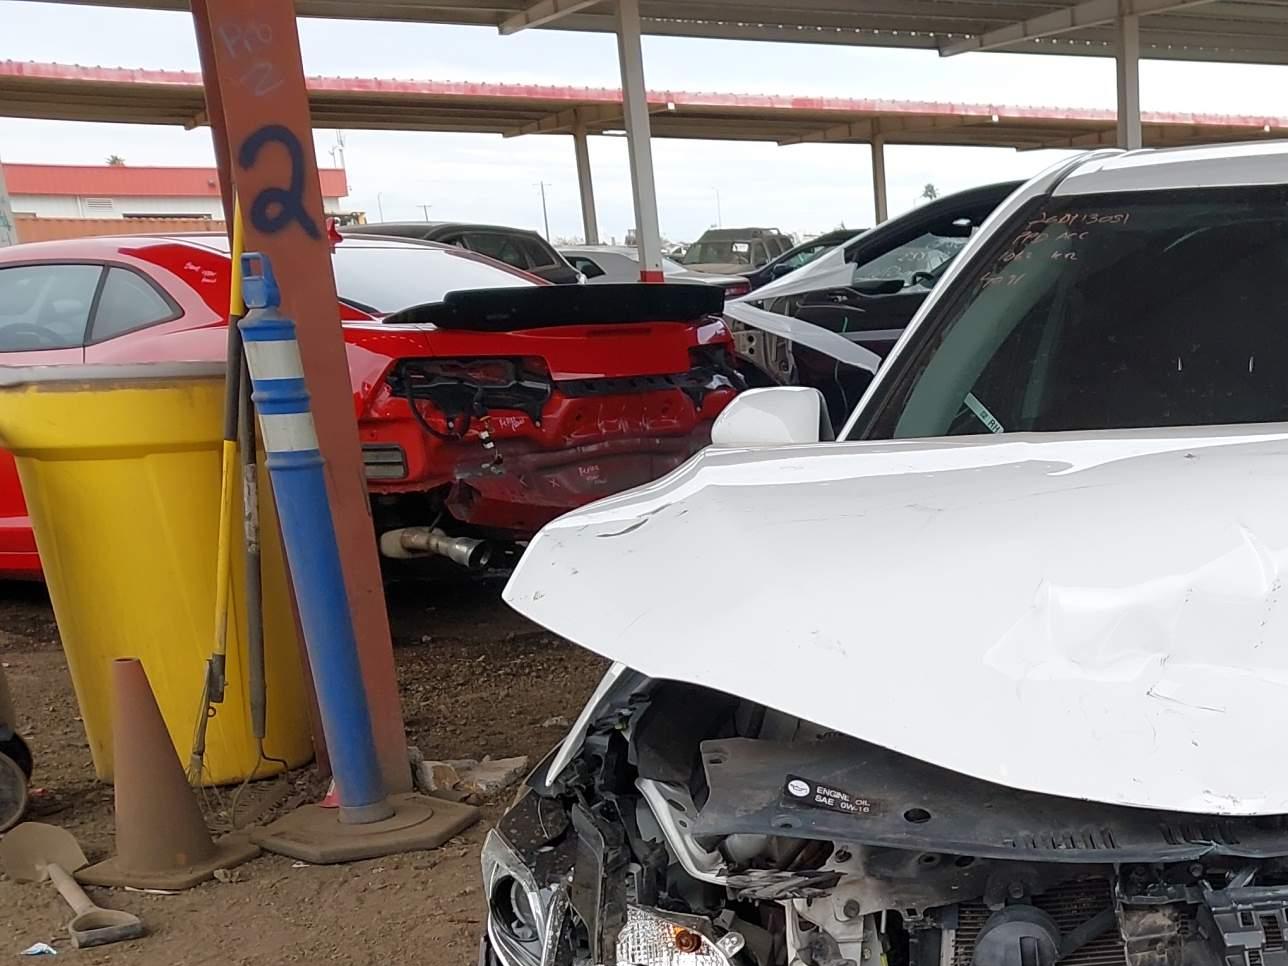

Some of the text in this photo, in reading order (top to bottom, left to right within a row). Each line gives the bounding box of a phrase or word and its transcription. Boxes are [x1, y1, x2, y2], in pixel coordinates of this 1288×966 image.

[239, 125, 321, 238] 2
[815, 795, 834, 806] SAE
[816, 786, 871, 807] ENGINE OIL
